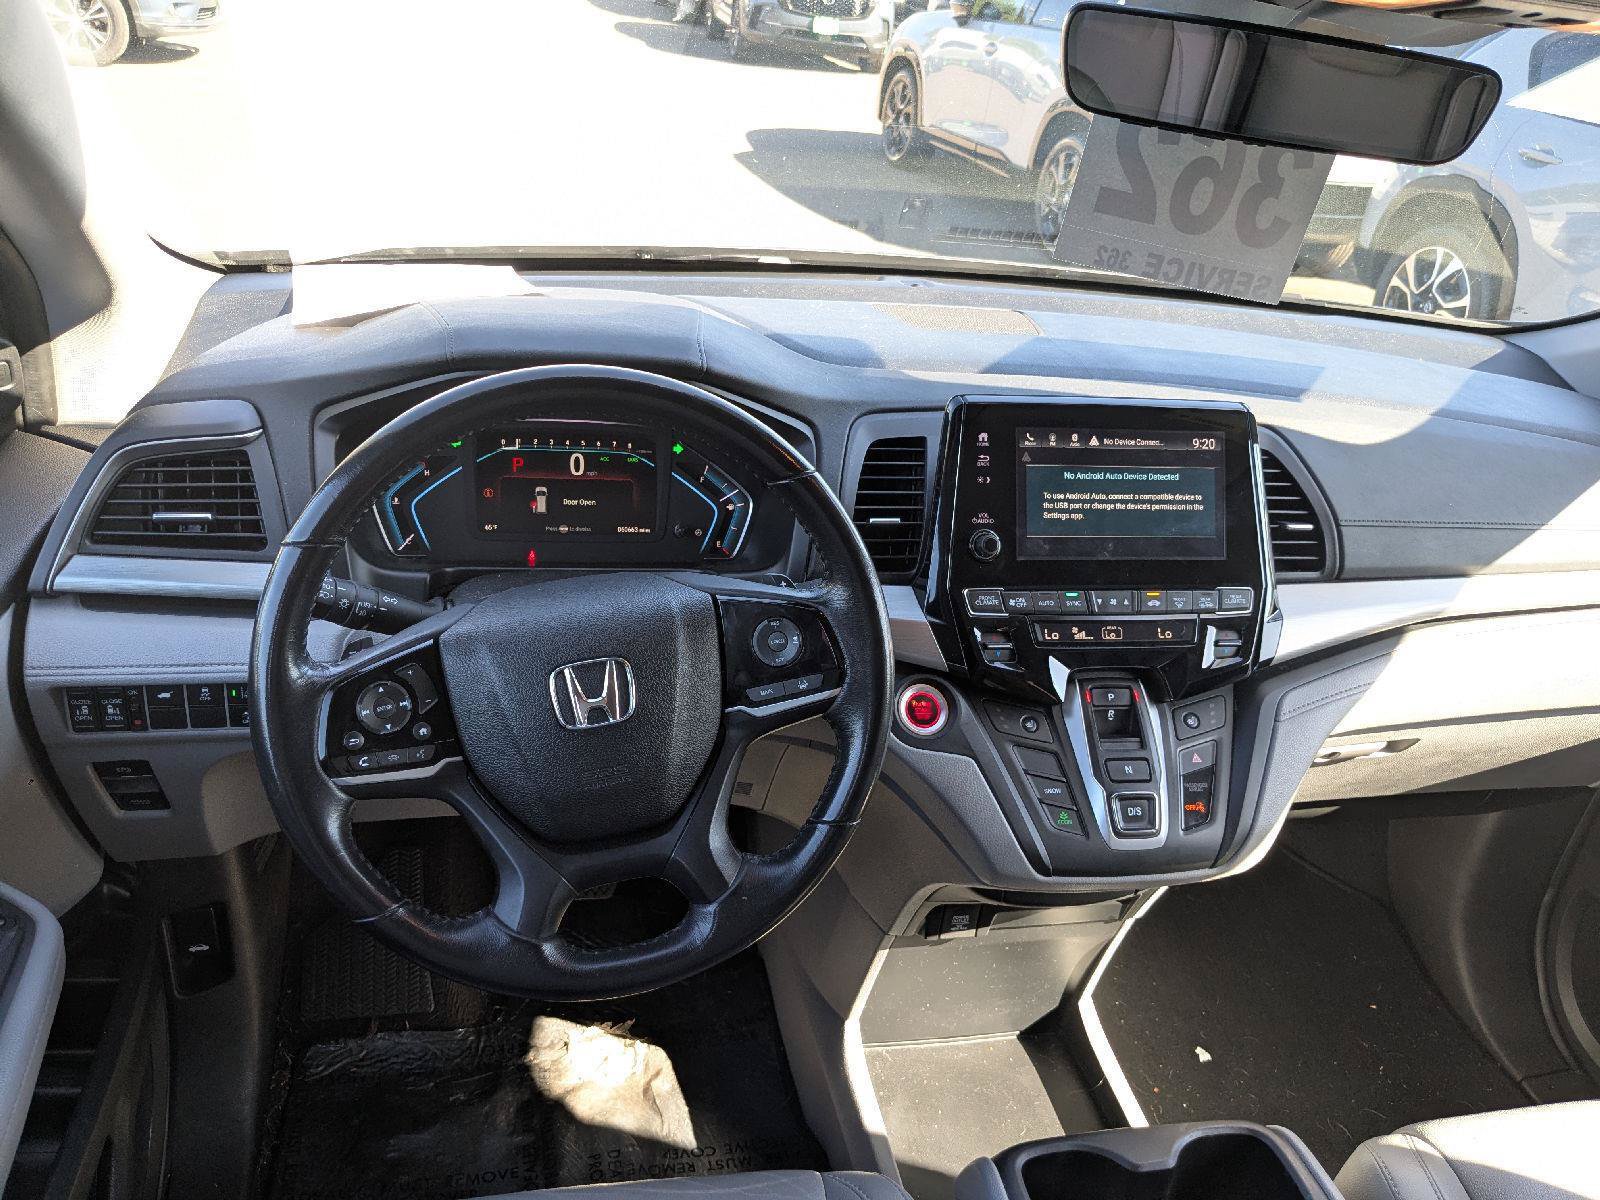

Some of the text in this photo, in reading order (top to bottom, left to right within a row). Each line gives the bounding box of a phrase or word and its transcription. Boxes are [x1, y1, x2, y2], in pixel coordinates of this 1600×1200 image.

[1192, 438, 1216, 450] 9:20
[512, 457, 524, 472] P
[569, 452, 585, 476] 0
[579, 499, 597, 507] Open
[1043, 512, 1070, 520] Settings
[1125, 766, 1133, 774] N
[1127, 807, 1142, 816] D/S
